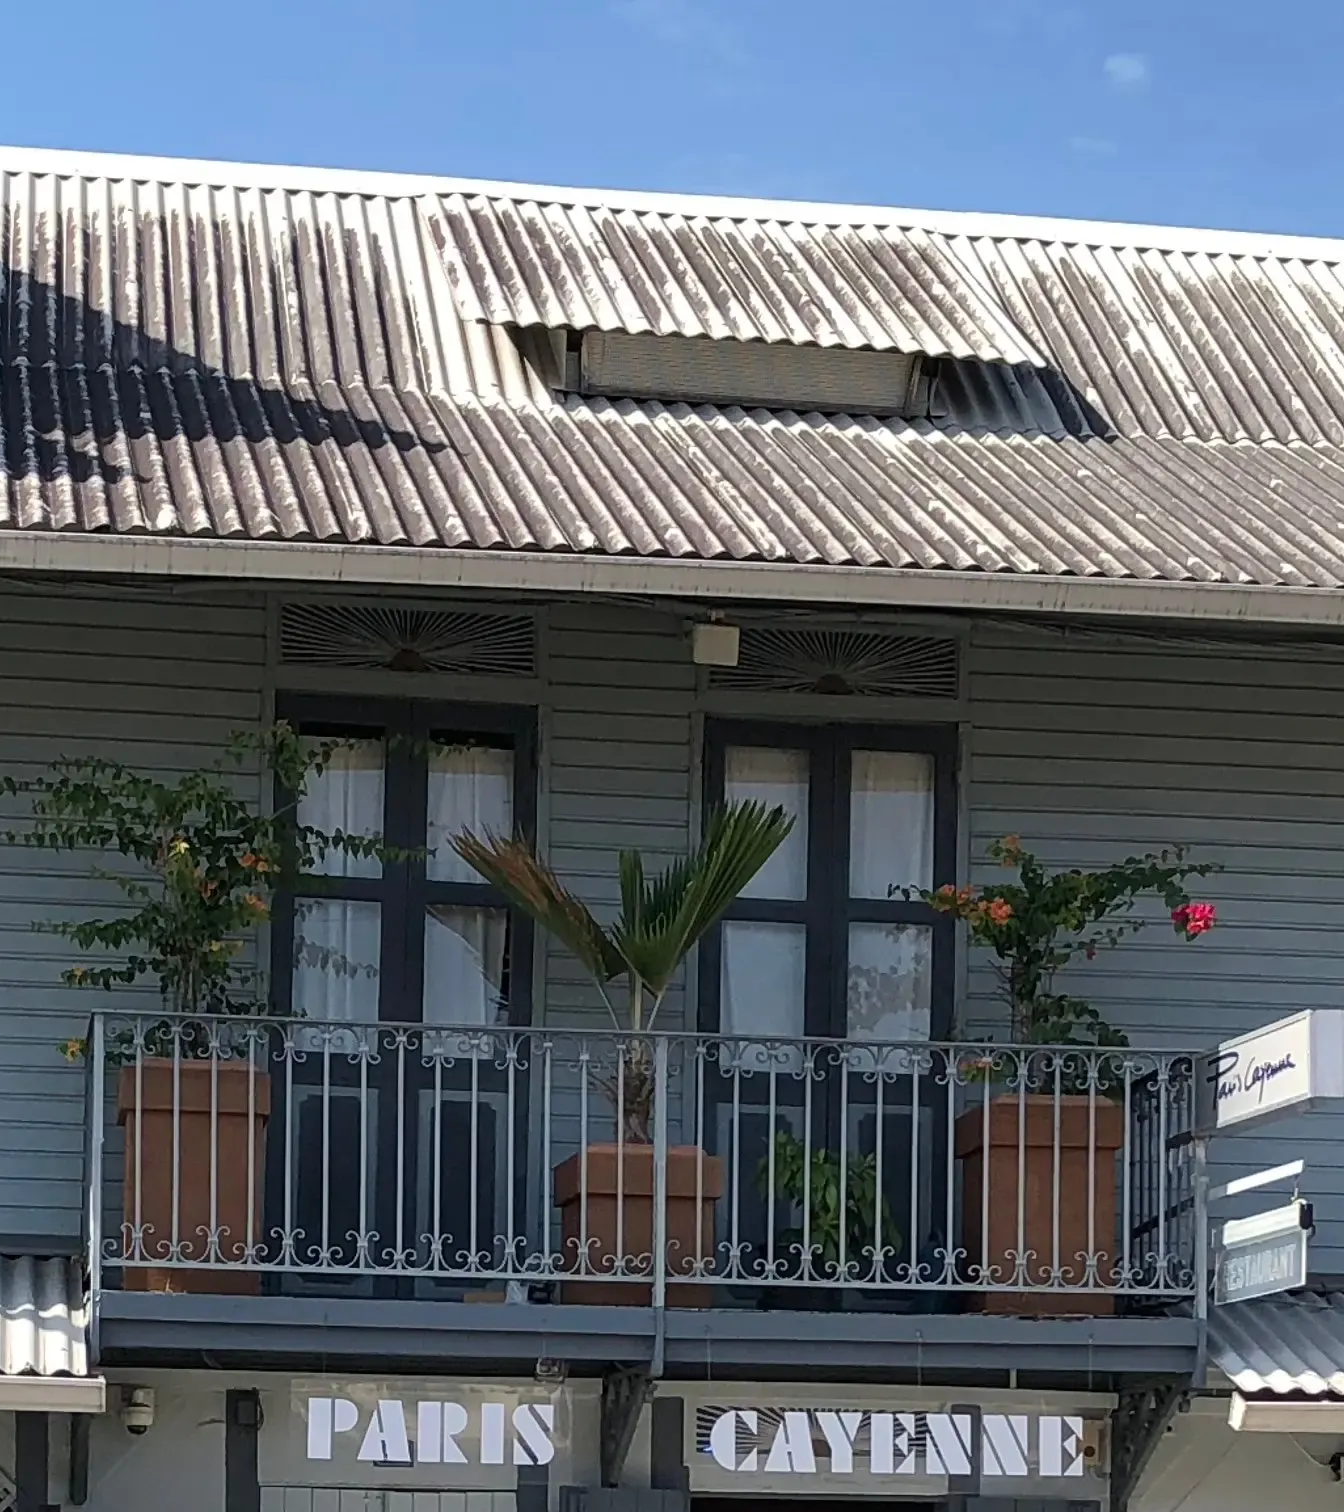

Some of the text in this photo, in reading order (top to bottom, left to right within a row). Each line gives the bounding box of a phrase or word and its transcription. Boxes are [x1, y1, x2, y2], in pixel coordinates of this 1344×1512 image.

[1206, 1052, 1296, 1110] Paris Cayenne
[306, 1397, 1085, 1477] PARIS CAYENNE
